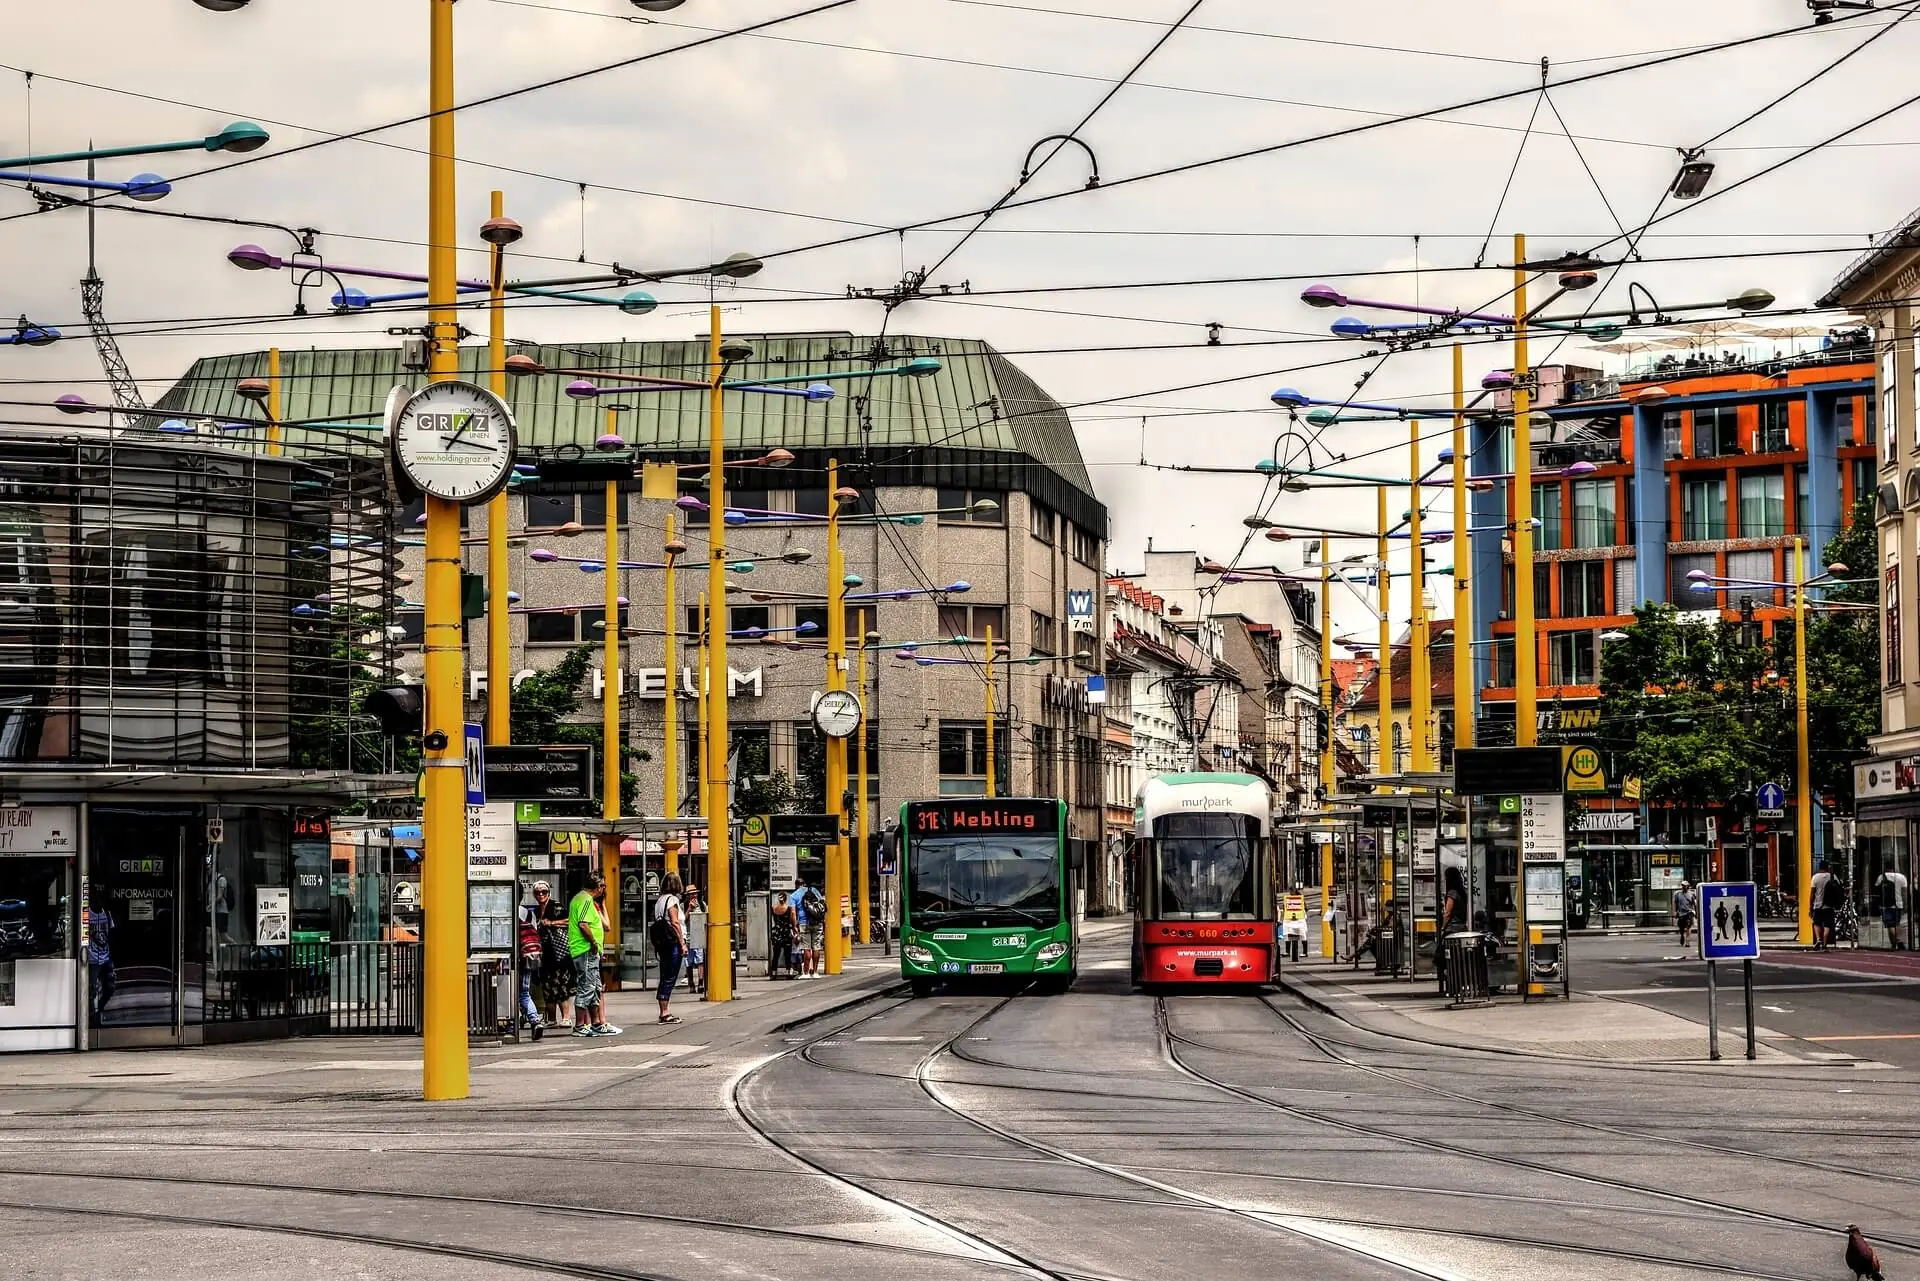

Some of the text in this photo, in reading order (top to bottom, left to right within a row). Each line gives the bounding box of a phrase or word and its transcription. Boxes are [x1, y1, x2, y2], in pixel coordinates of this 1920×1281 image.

[417, 414, 489, 431] GRAZ
[1070, 596, 1090, 612] W
[1074, 620, 1080, 629] 7
[1560, 710, 1601, 729] INN
[1504, 798, 1514, 809] G
[1523, 798, 1533, 806] 13
[379, 806, 402, 816] WC
[523, 804, 533, 817] F
[1523, 808, 1533, 816] 26
[469, 818, 480, 827] 30
[918, 811, 1035, 830] 31E Webling
[1524, 819, 1534, 827] 30
[1602, 815, 1620, 829] CASE
[469, 830, 480, 840] 31
[1524, 830, 1534, 838] 31
[469, 843, 480, 852] 39
[1524, 841, 1535, 849] 39
[119, 859, 163, 872] GRAZ
[300, 874, 317, 886] TICKETS
[112, 889, 173, 898] INFORMATION
[1199, 930, 1217, 938] 660
[993, 936, 1025, 946] GRAZ
[1177, 949, 1238, 957] www.murpark.at
